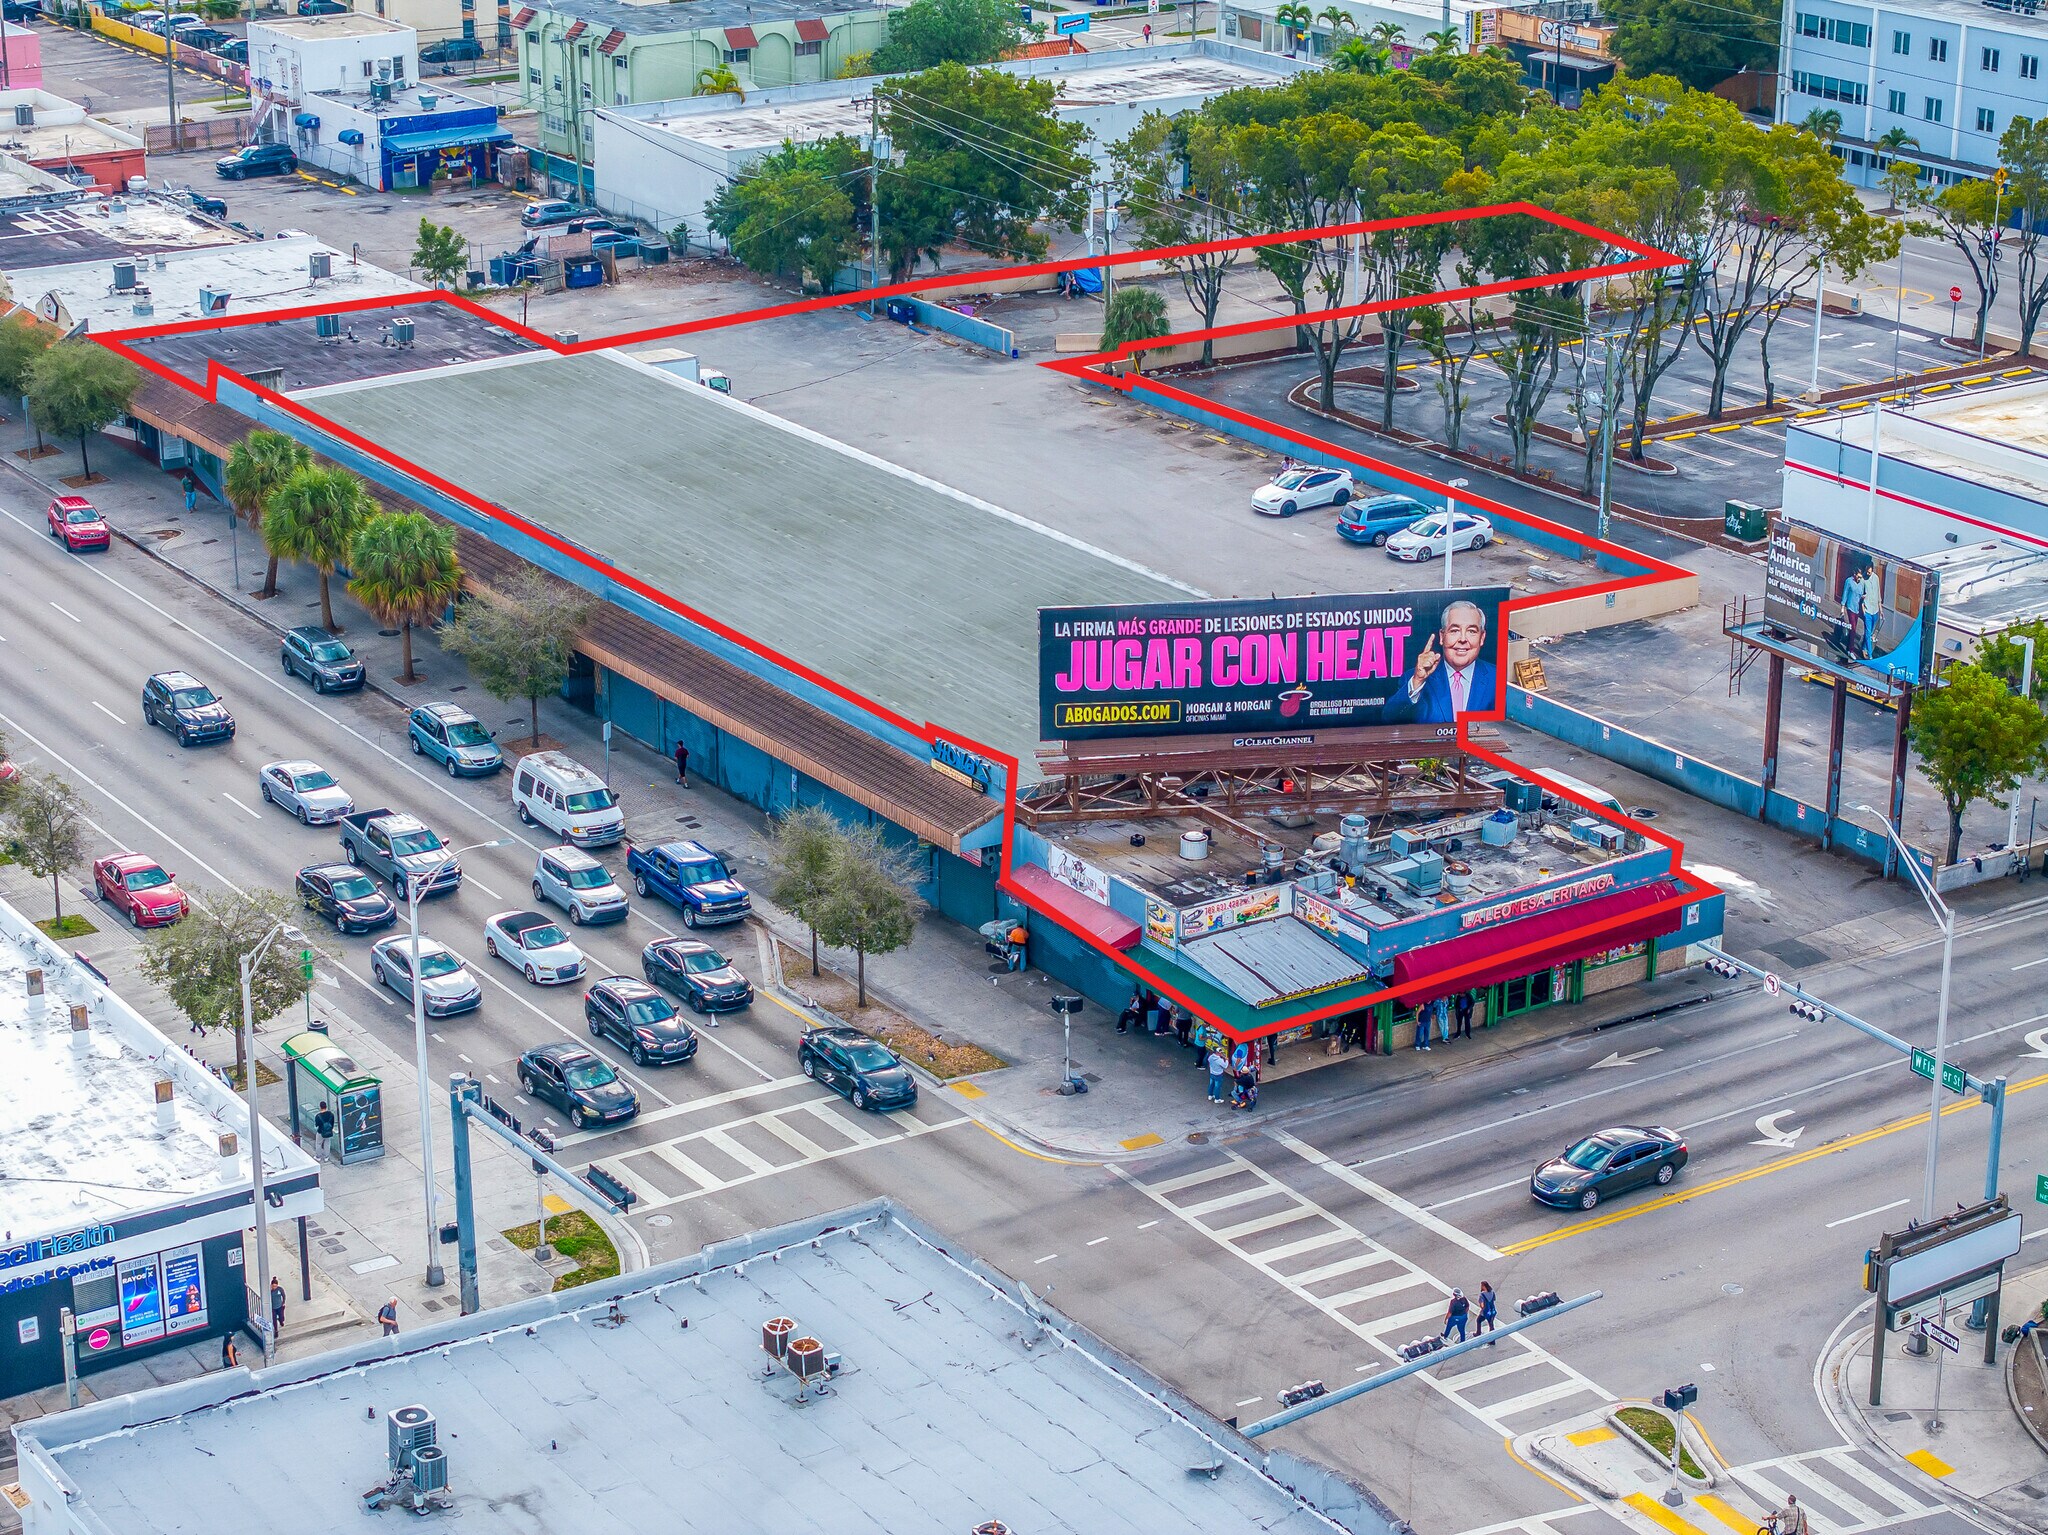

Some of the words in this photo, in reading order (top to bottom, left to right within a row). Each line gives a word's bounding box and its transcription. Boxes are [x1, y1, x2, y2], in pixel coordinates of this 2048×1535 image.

[1771, 532, 1796, 552] Latin
[1770, 548, 1811, 574] America
[1768, 564, 1774, 574] is
[1774, 566, 1804, 586] included
[1804, 578, 1812, 588] in
[1768, 577, 1779, 588] our
[1780, 581, 1805, 598] newest
[1806, 590, 1821, 604] plan
[1054, 622, 1071, 637] LA
[1074, 621, 1115, 637] FIRMA
[1118, 617, 1146, 636] MÁS
[1150, 618, 1202, 635] GRANDE
[1204, 618, 1221, 633] DE
[1224, 614, 1284, 632] LESIONES
[1287, 613, 1303, 628] DE
[1306, 610, 1361, 627] ESTADOS
[1364, 607, 1413, 625] UNIDOS
[1767, 592, 1786, 604] Available
[1829, 616, 1841, 626] extra
[1842, 620, 1852, 630] cost
[1055, 637, 1202, 692] JUGAR
[1211, 631, 1298, 688] CON
[1306, 626, 1412, 682] HEAT
[1065, 704, 1170, 723] ABOGADOS.COM
[1186, 702, 1223, 714] MORGAN
[1225, 702, 1232, 712] &
[1234, 700, 1271, 712] MORGAN
[1310, 700, 1342, 708] ORGULLOSO
[1343, 697, 1385, 706] PATROCINADOR
[1463, 913, 1482, 928] LA
[1484, 896, 1546, 922] LEONESA
[1552, 874, 1615, 903] FRITANGA
[1915, 1054, 1922, 1067] W
[1923, 1057, 1952, 1082] Flaer
[1953, 1075, 1961, 1087] St
[56, 1256, 116, 1280] Center
[74, 1268, 113, 1282] MEDICINA
[122, 1273, 147, 1284] RAYOS
[1932, 1328, 1943, 1340] ONE
